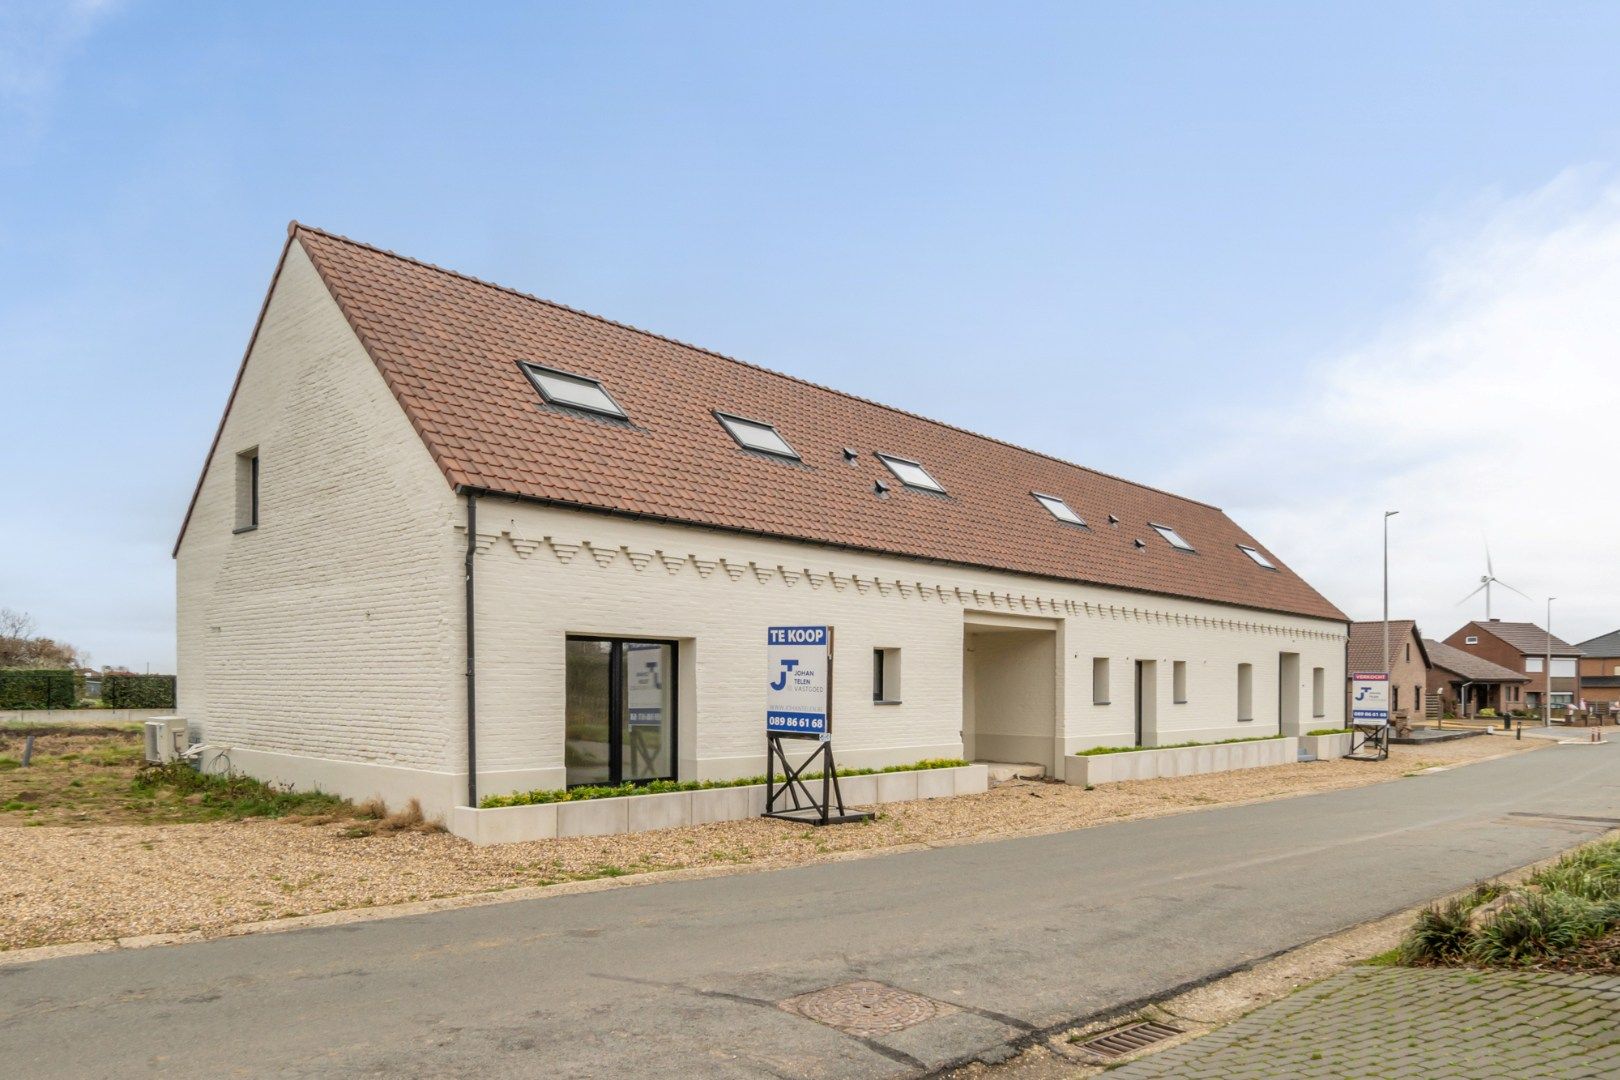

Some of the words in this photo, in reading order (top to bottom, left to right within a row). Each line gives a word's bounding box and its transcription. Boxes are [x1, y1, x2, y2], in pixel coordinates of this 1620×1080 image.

[770, 629, 786, 643] TE
[788, 629, 824, 643] KOOP
[769, 716, 786, 726] 089
[786, 717, 798, 727] 86
[799, 718, 810, 728] 61
[811, 719, 823, 729] 68
